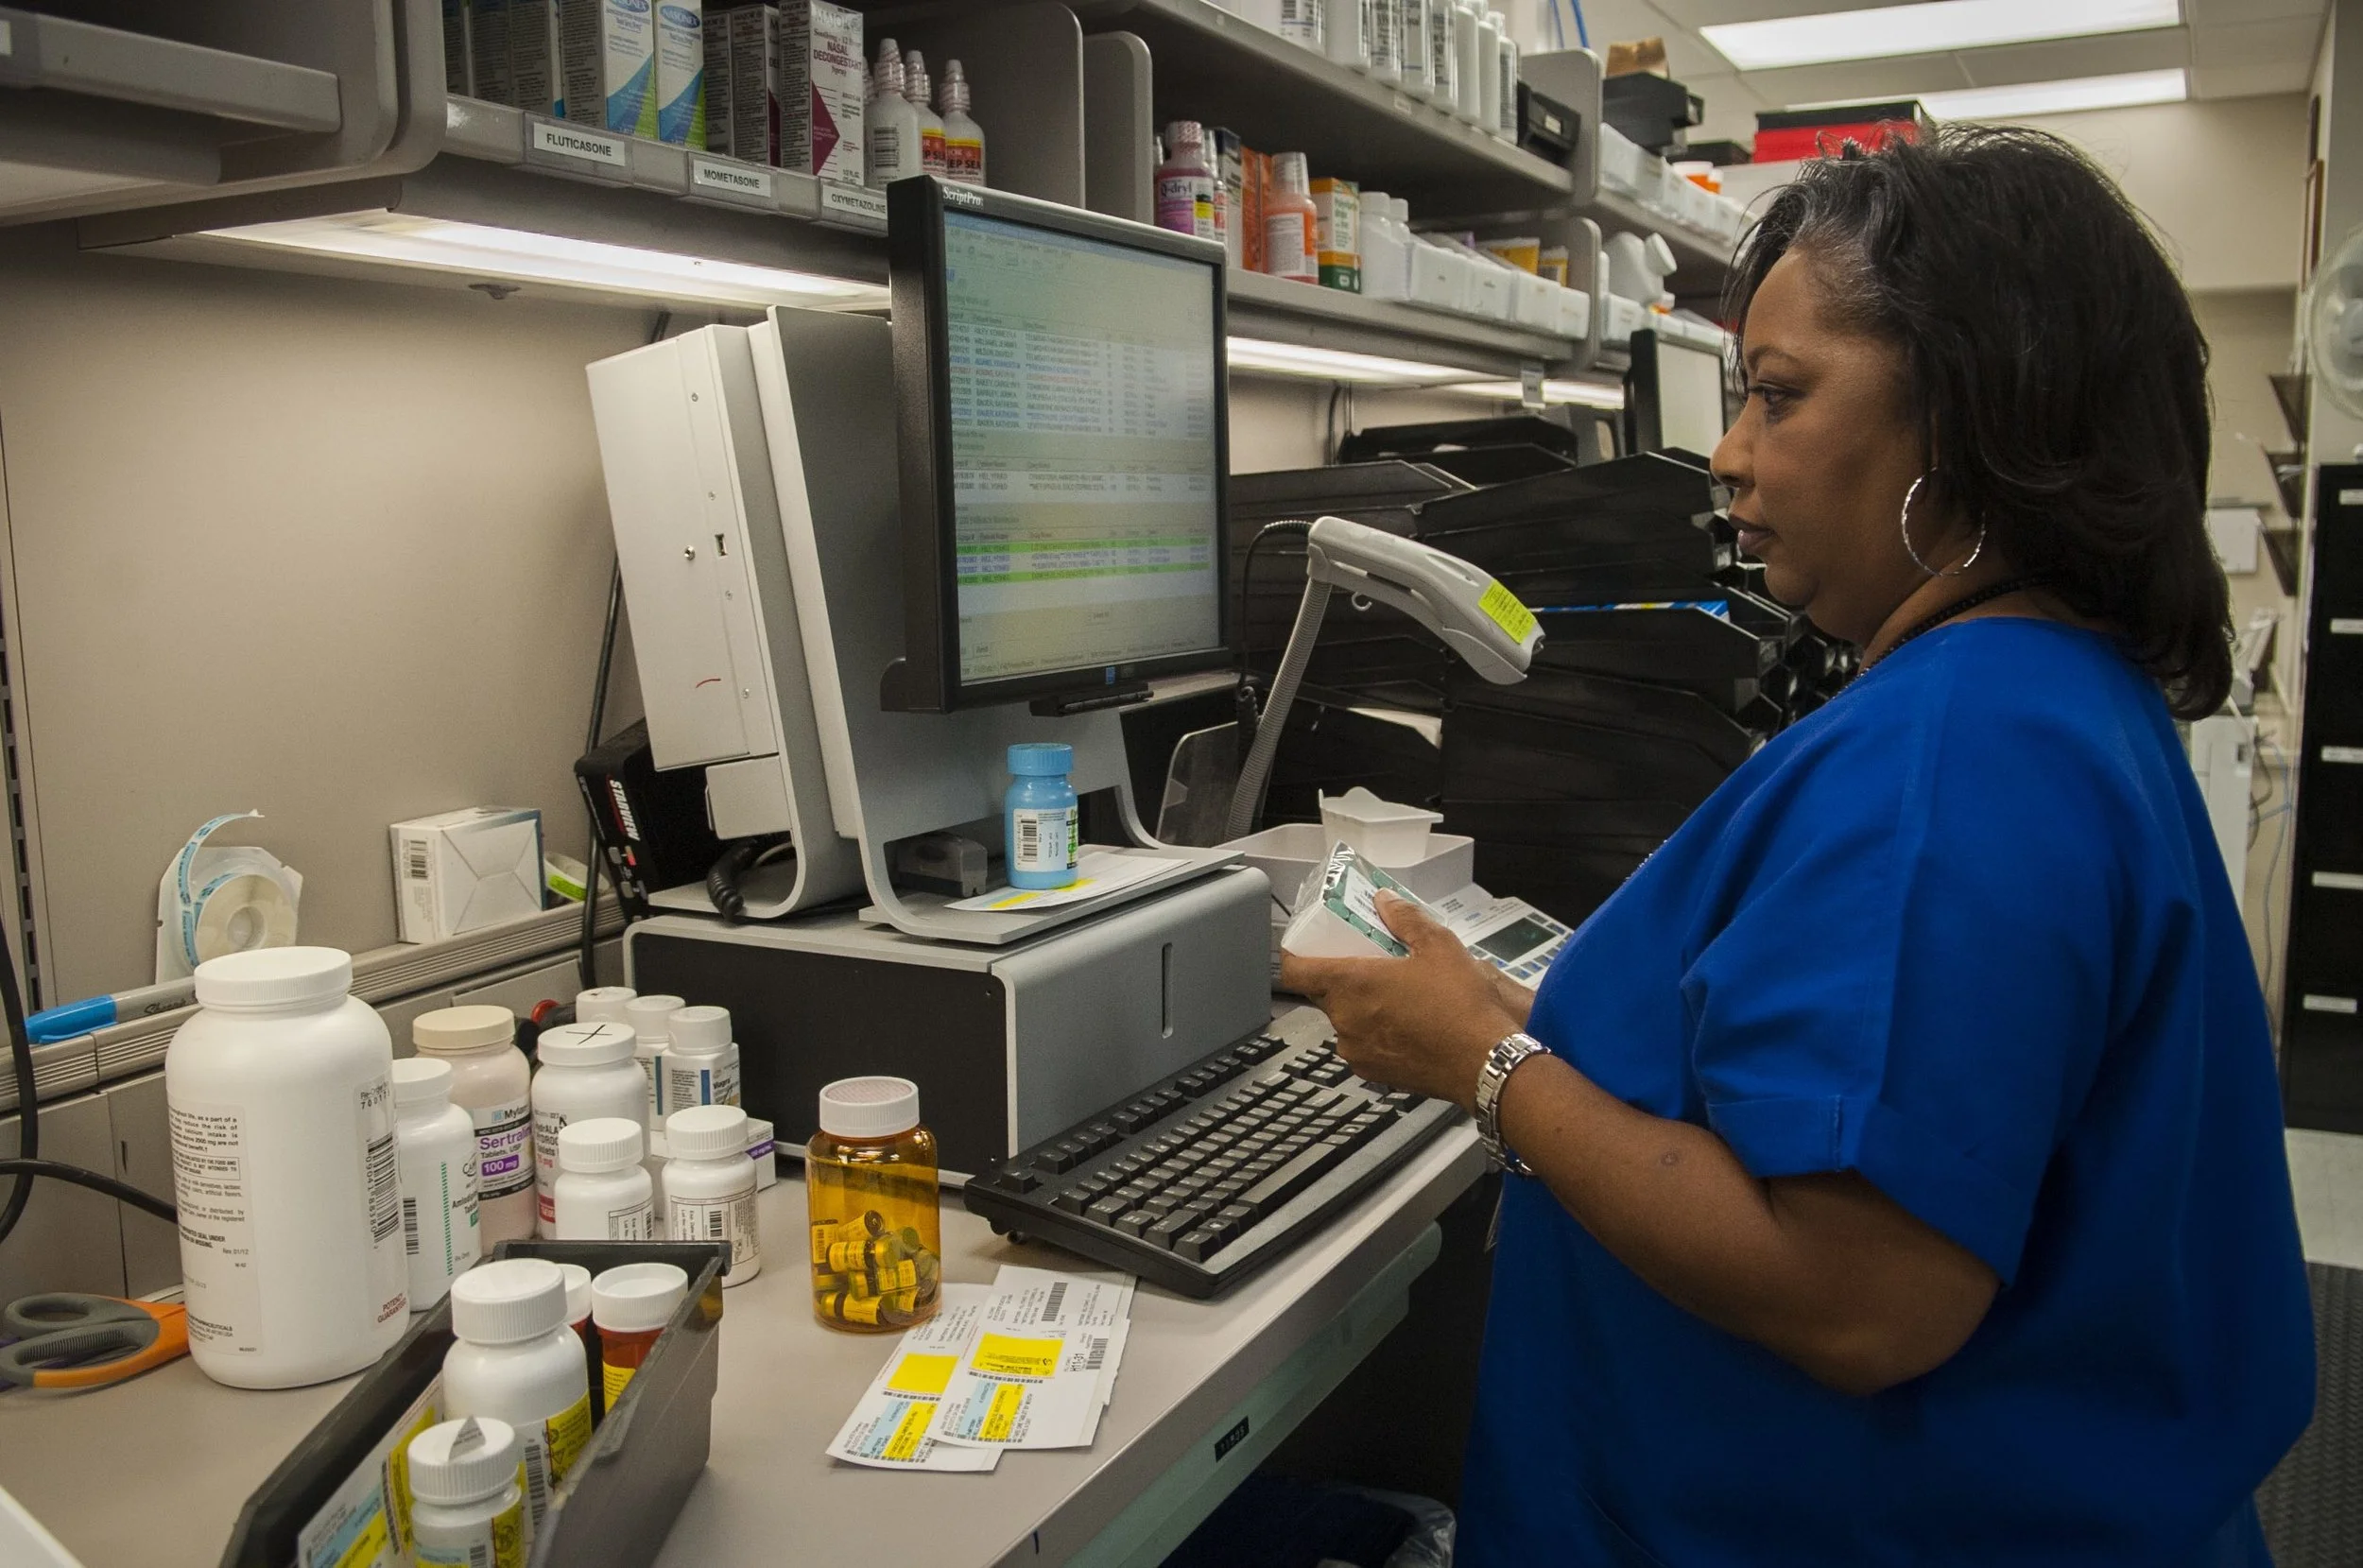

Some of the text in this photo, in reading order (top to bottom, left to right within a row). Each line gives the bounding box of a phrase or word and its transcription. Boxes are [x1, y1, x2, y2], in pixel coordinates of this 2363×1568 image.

[813, 49, 862, 71] DECONGESTANT
[827, 42, 848, 56] NASAL
[545, 132, 612, 157] FLUTICASONE
[703, 168, 760, 190] MOMETASONE
[831, 193, 886, 215] OXYMETAZOLINE
[942, 185, 981, 207] ScriptPro
[609, 779, 641, 842] STARVIEW
[484, 1160, 518, 1173] 100 mg
